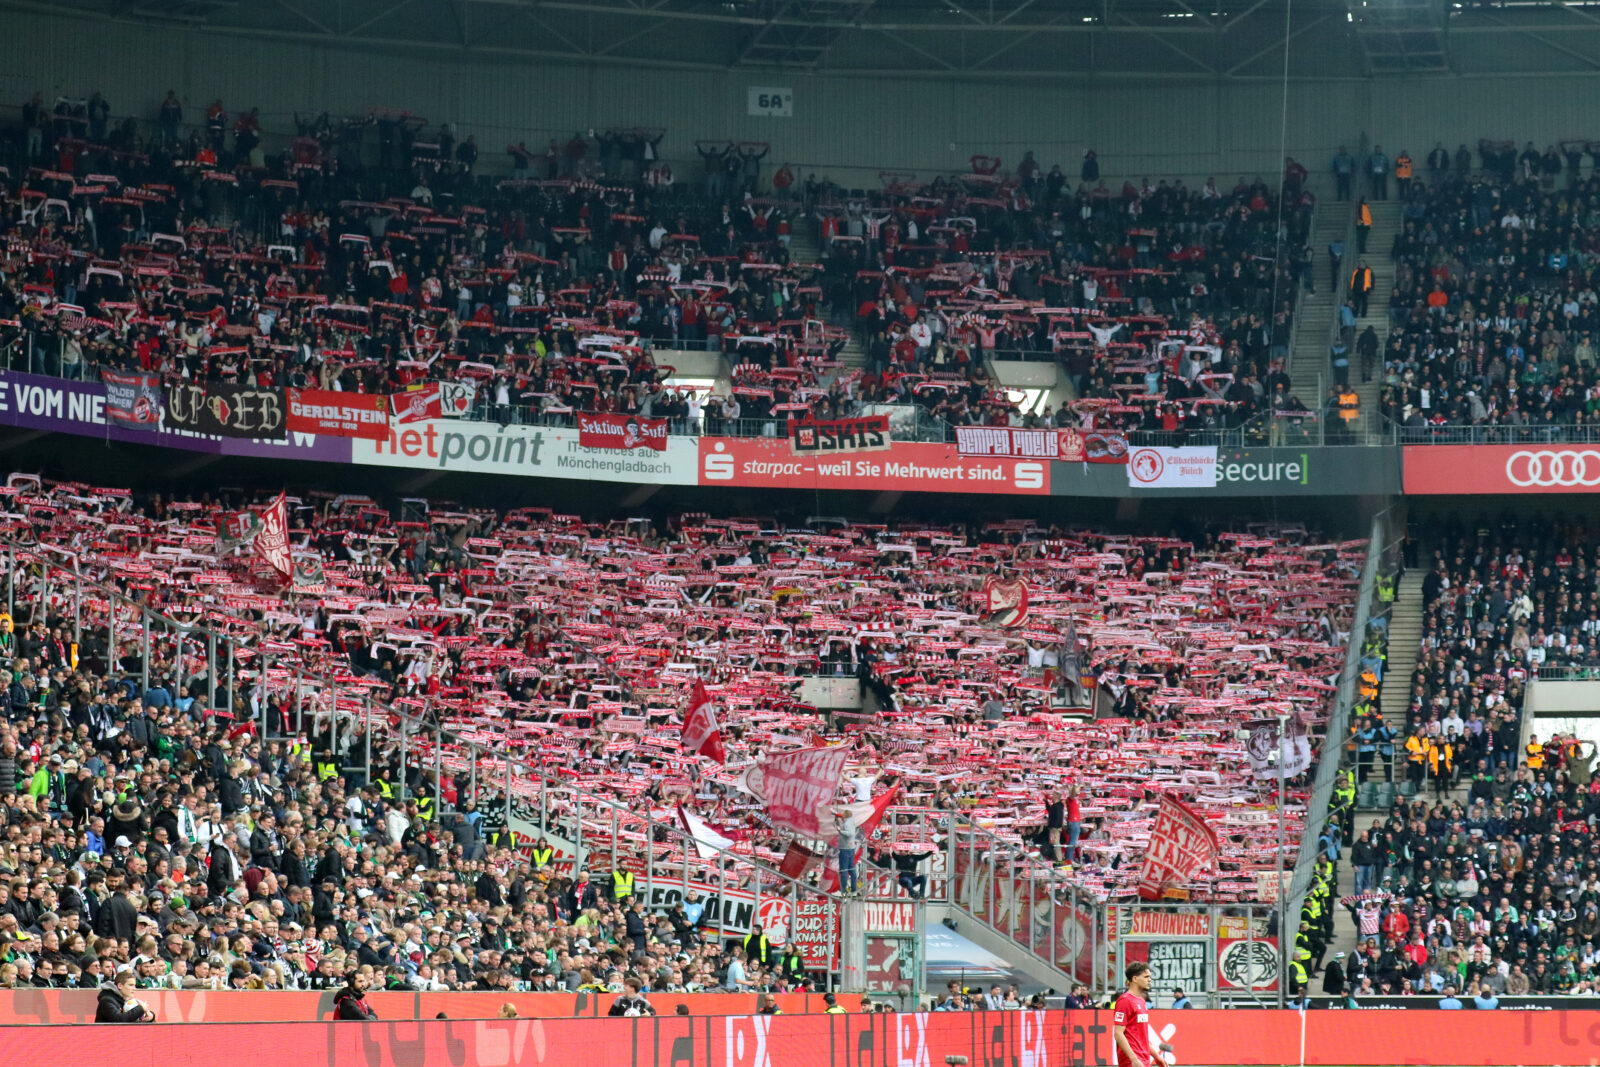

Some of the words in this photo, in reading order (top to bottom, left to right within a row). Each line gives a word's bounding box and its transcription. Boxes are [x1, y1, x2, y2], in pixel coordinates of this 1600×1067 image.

[14, 383, 63, 418] VOM
[291, 402, 387, 425] GEROLSTEIN
[319, 420, 340, 429] SINCE
[581, 418, 625, 436] Sektion
[375, 424, 546, 466] netpoint
[957, 428, 1010, 454] SEMPER
[1012, 430, 1058, 456] FIDELIS
[638, 447, 660, 458] aus
[557, 455, 672, 474] Mönchengladbach
[743, 460, 802, 478] starpac
[818, 461, 851, 476] weil
[855, 461, 880, 477] Sie
[885, 462, 963, 479] Mehrwert
[968, 465, 1007, 481] sind.
[797, 904, 837, 915] LEEVER
[796, 917, 822, 931] DUD
[1132, 911, 1210, 935] STADIONVERBO
[1151, 943, 1203, 959] SEKTION
[1150, 959, 1203, 980] STADT
